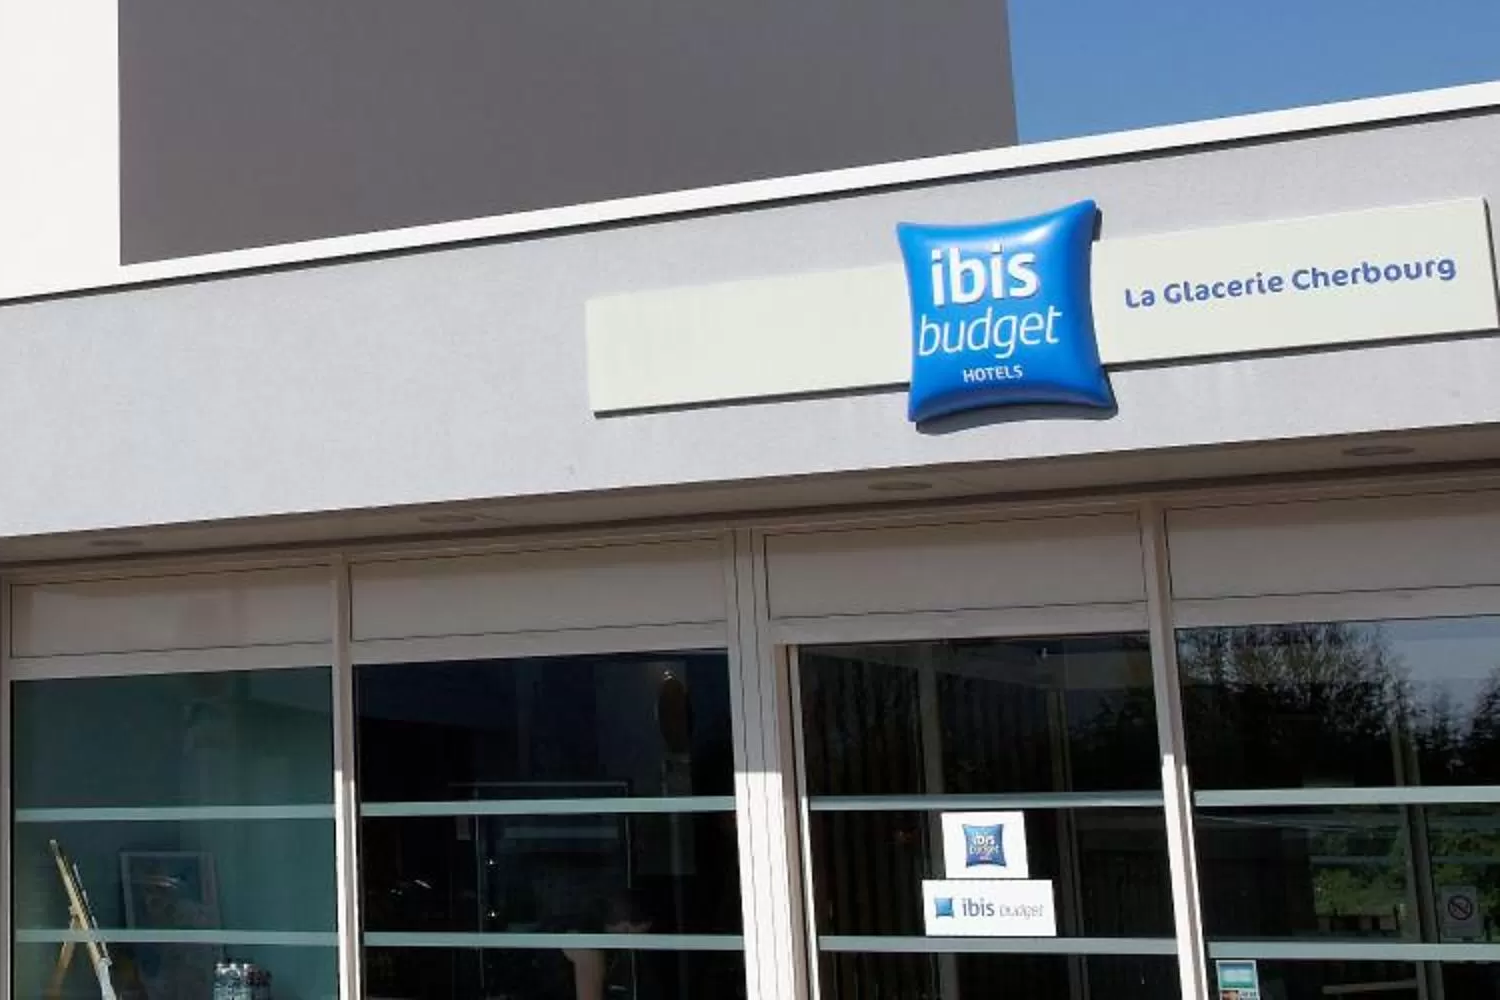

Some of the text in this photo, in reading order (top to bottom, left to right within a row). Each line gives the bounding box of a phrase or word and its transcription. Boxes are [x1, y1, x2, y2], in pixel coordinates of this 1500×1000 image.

[931, 243, 1040, 306] ibis
[1124, 258, 1457, 308] La Glacerie Cherbourg
[918, 305, 1063, 359] budget
[963, 365, 1023, 383] HOTELS
[962, 897, 995, 917] ibis
